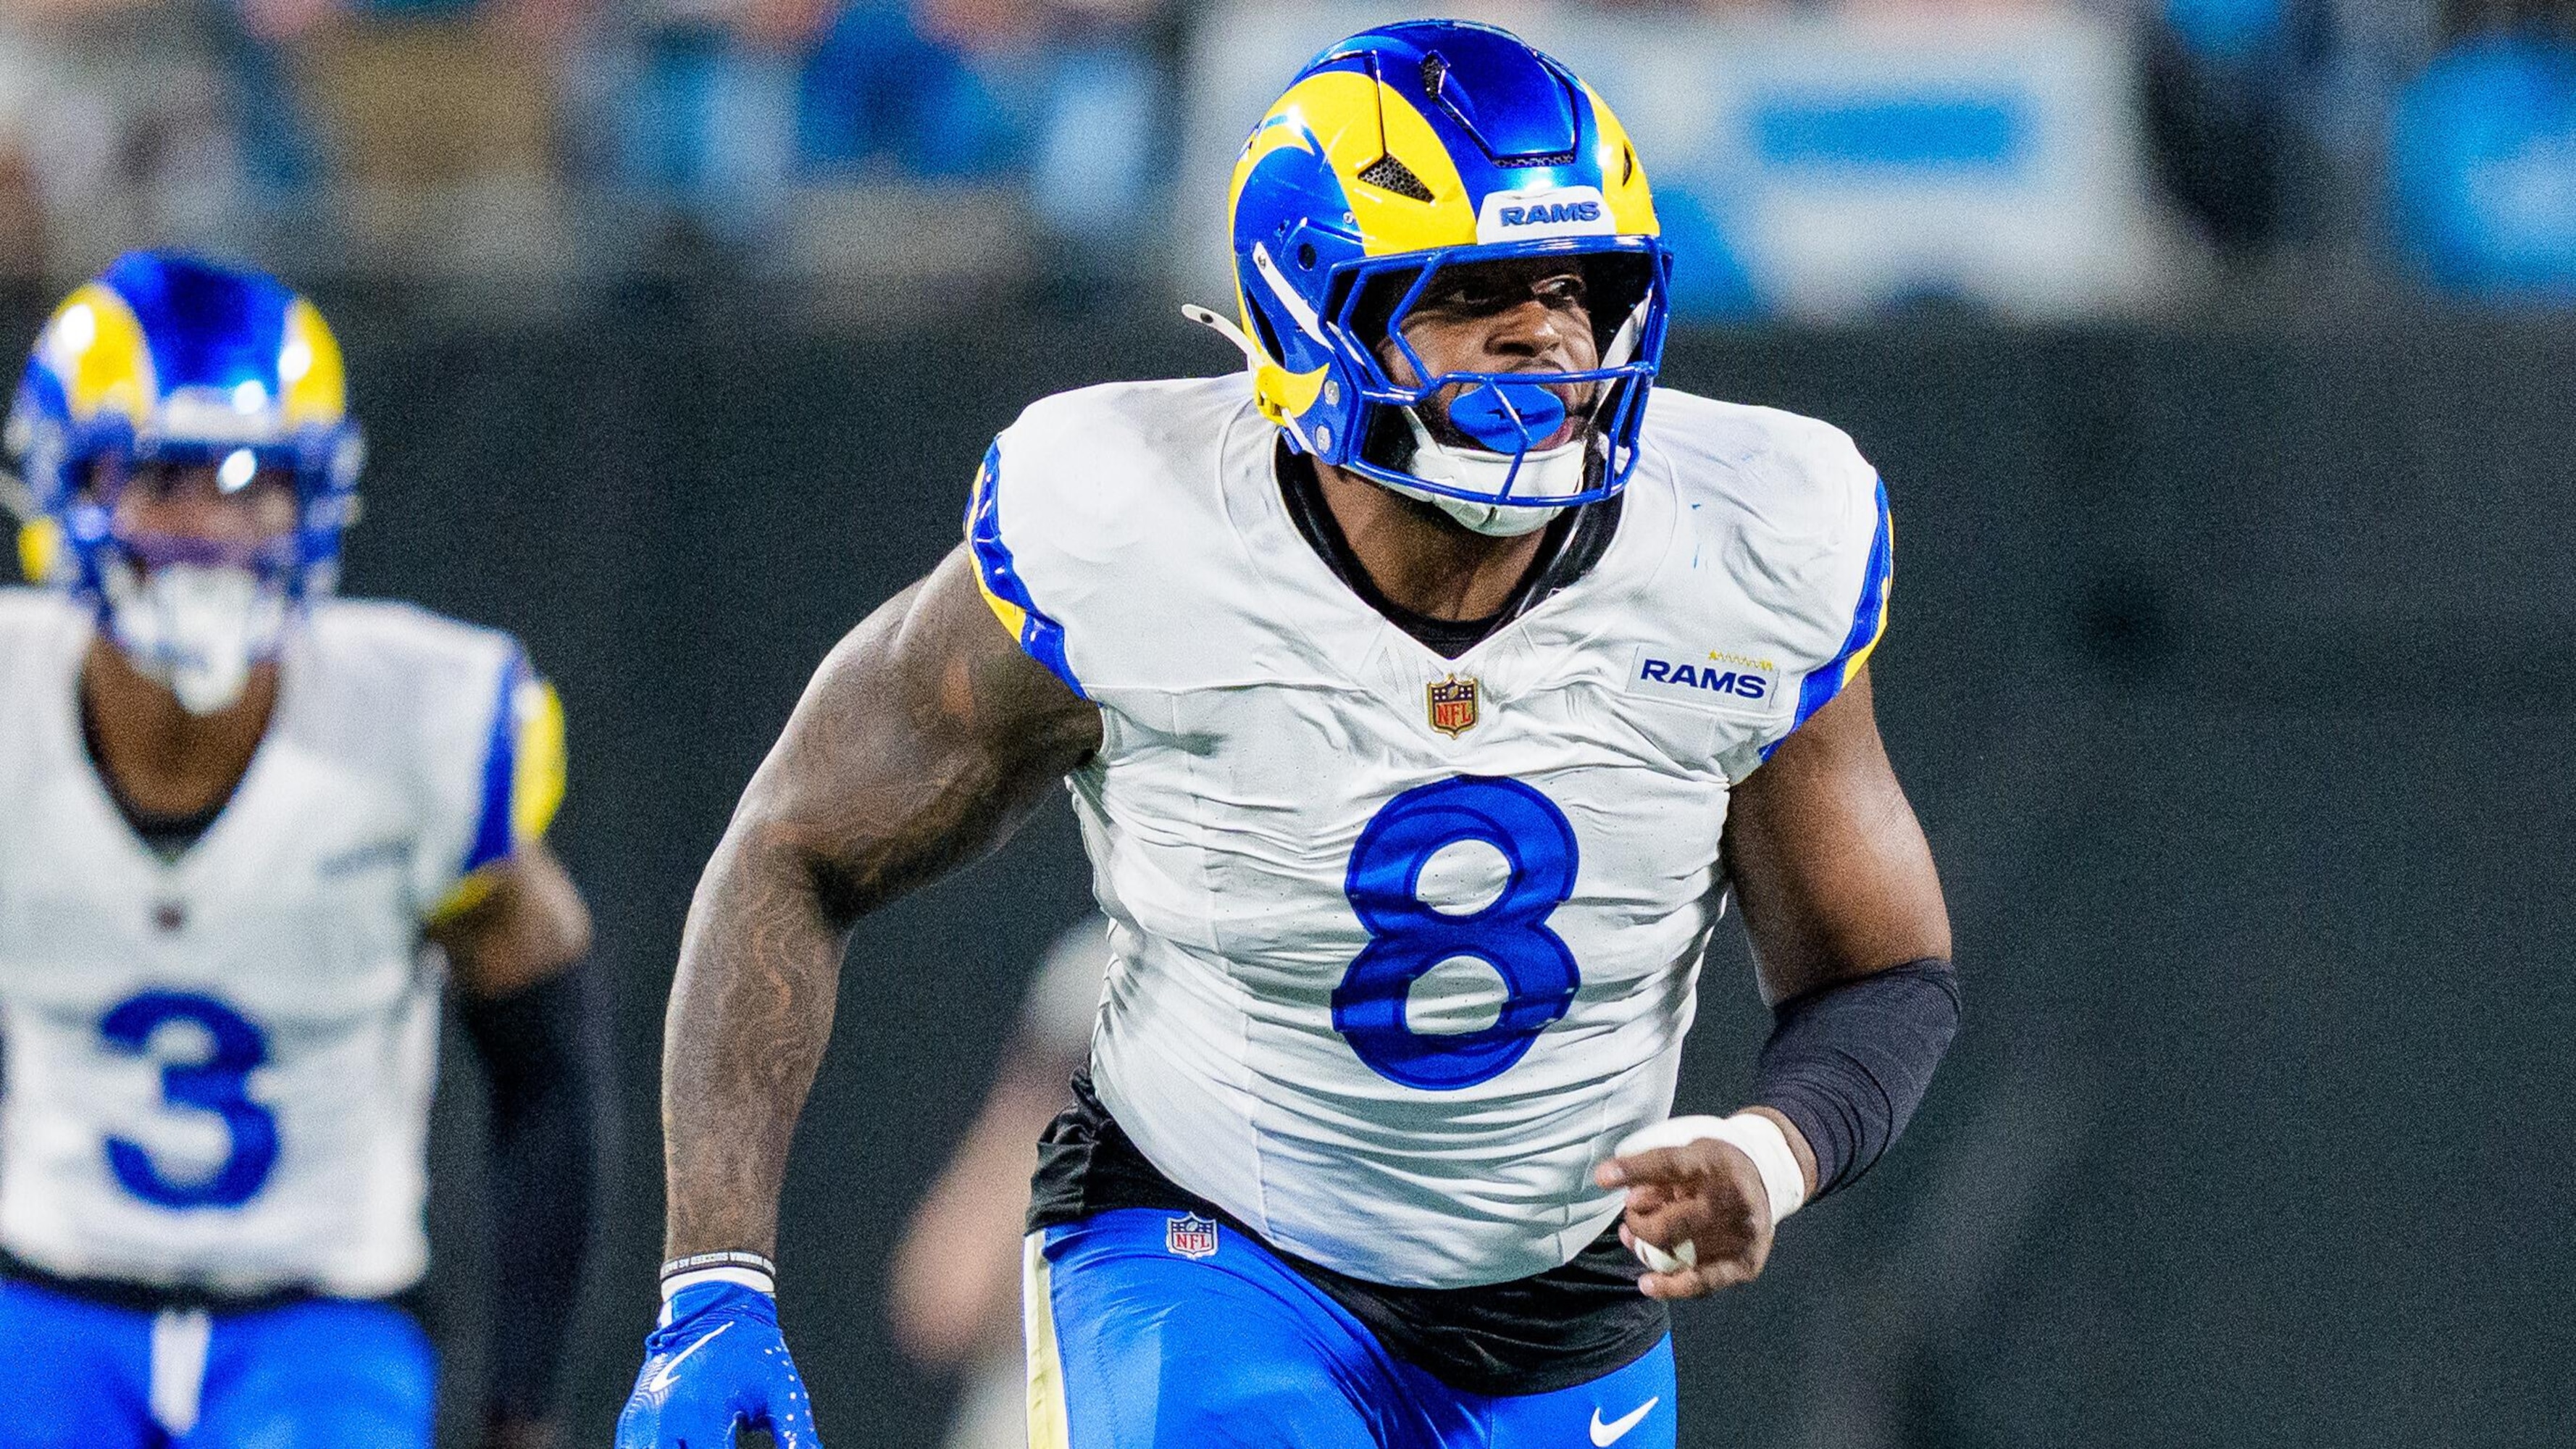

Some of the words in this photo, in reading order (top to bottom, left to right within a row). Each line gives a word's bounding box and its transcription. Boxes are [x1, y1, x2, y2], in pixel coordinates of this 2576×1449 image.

[1499, 201, 1601, 227] RAMS
[1640, 659, 1767, 699] RAMS
[1436, 702, 1472, 726] NFL
[1331, 774, 1581, 1091] 8
[99, 989, 282, 1211] 3
[1175, 1233, 1210, 1250] NFL
